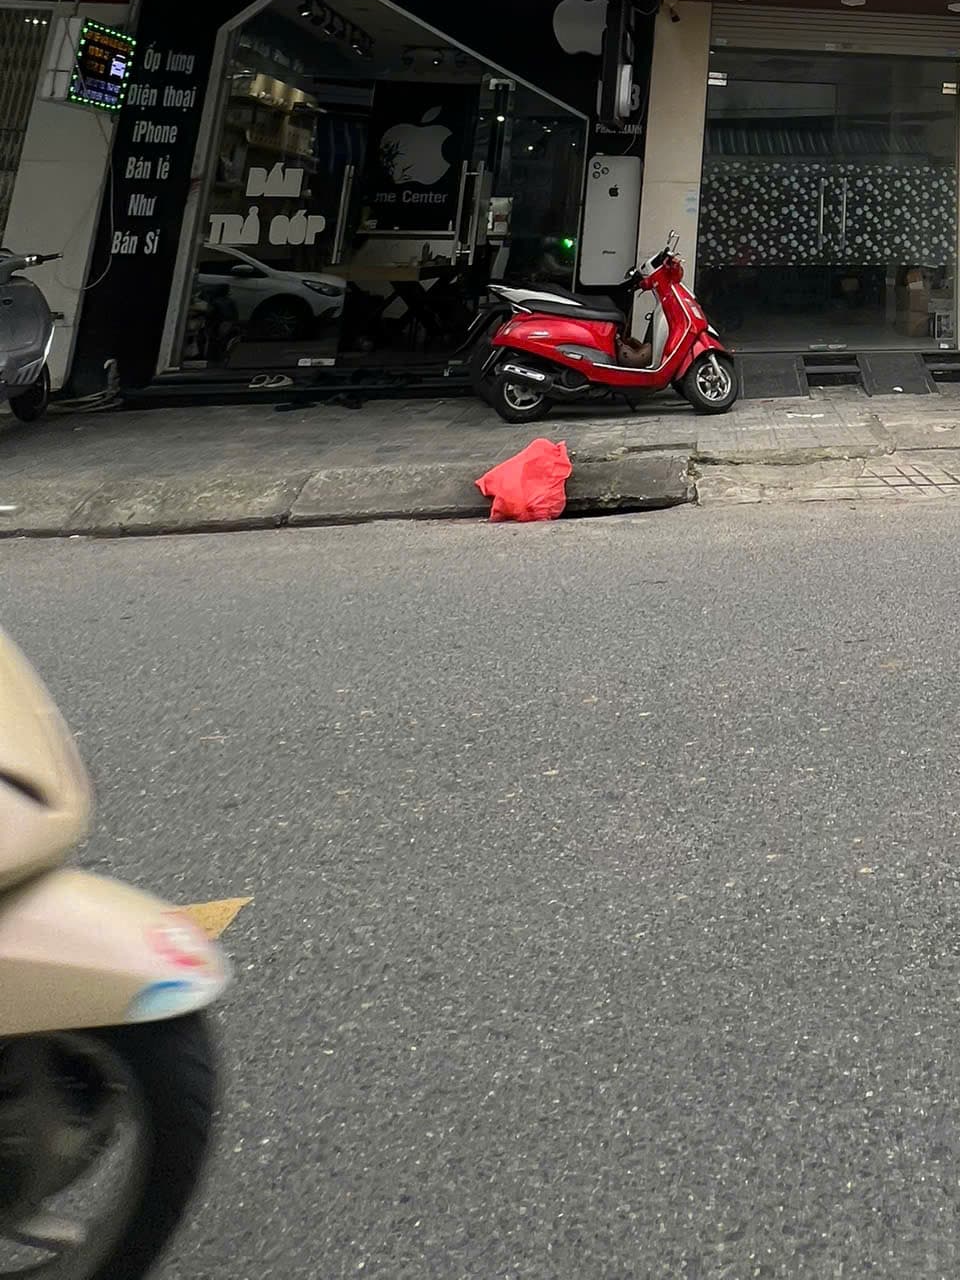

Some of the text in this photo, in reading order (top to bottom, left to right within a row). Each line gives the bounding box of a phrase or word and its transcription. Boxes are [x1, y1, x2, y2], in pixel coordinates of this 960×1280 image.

[144, 41, 161, 72] Ốp
[166, 49, 196, 75] lưng
[127, 83, 157, 111] Điện
[162, 84, 198, 112] thoại
[132, 120, 178, 144] iPhone
[125, 155, 152, 180] Bán
[127, 192, 158, 217] Như
[402, 190, 449, 204] Center
[111, 228, 139, 255] Bán
